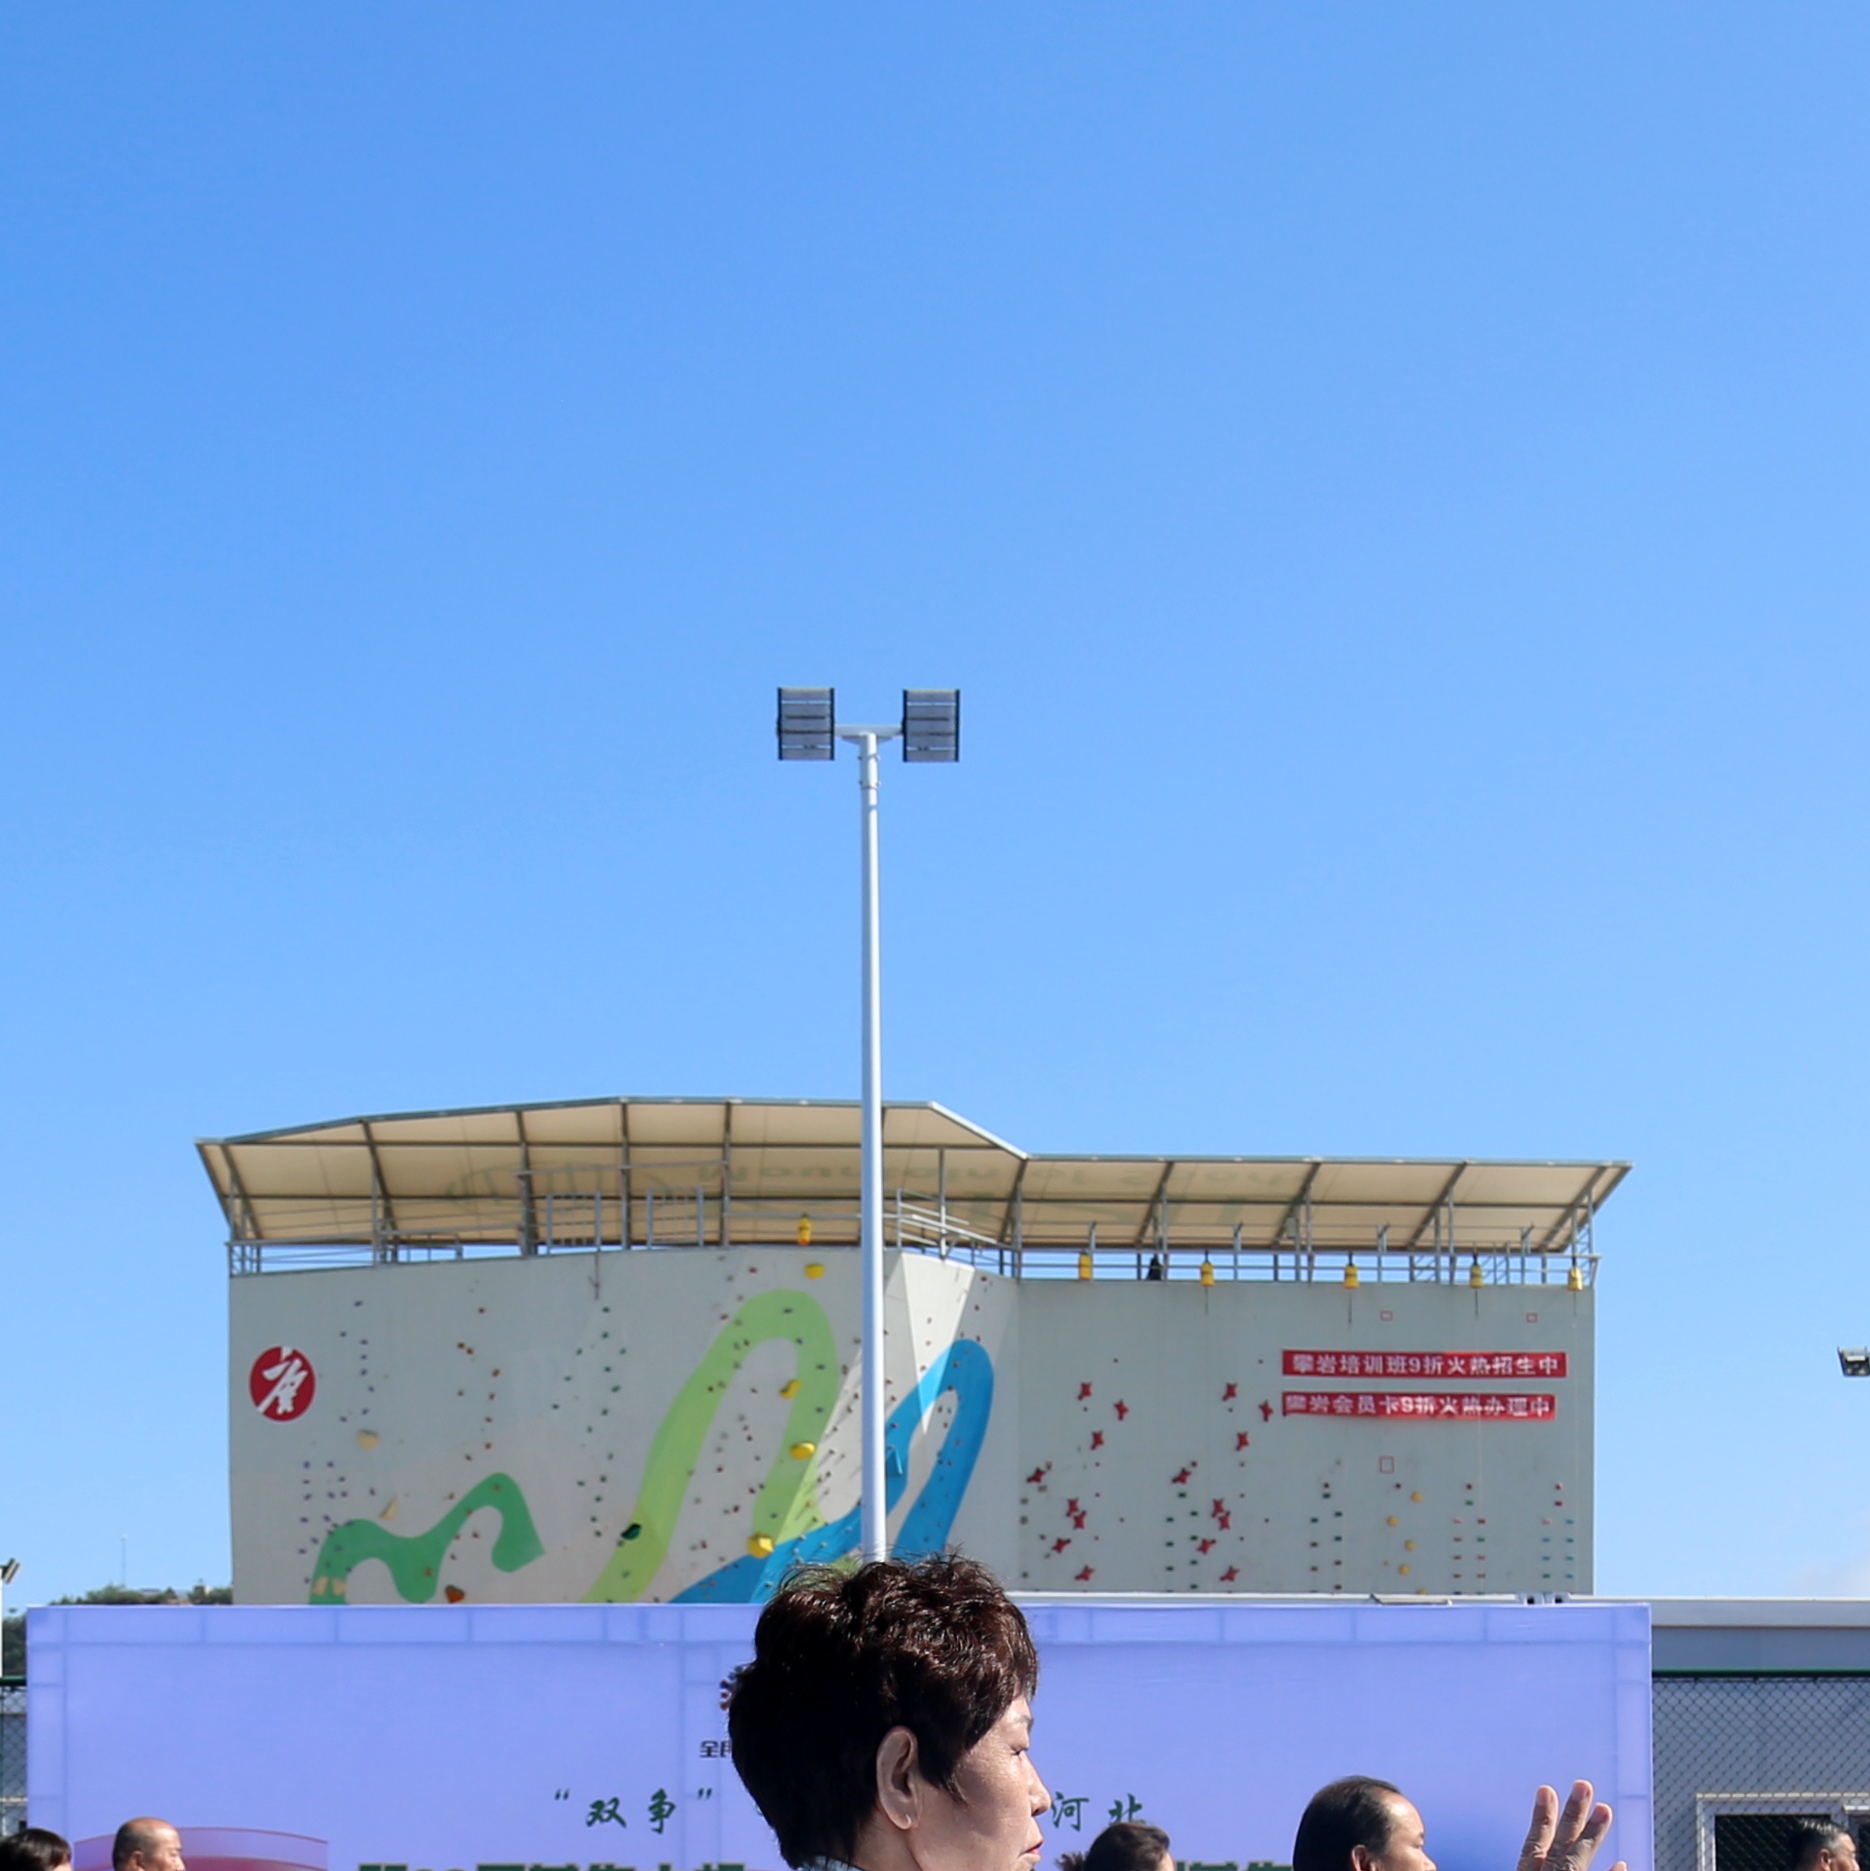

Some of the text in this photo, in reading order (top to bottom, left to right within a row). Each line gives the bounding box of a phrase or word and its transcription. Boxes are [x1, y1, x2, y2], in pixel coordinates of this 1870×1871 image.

[1292, 1353, 1559, 1376] 攀岩培训班9折火热招生中
[1285, 1393, 1551, 1417] 攀岩会员卡9折火热办理中
